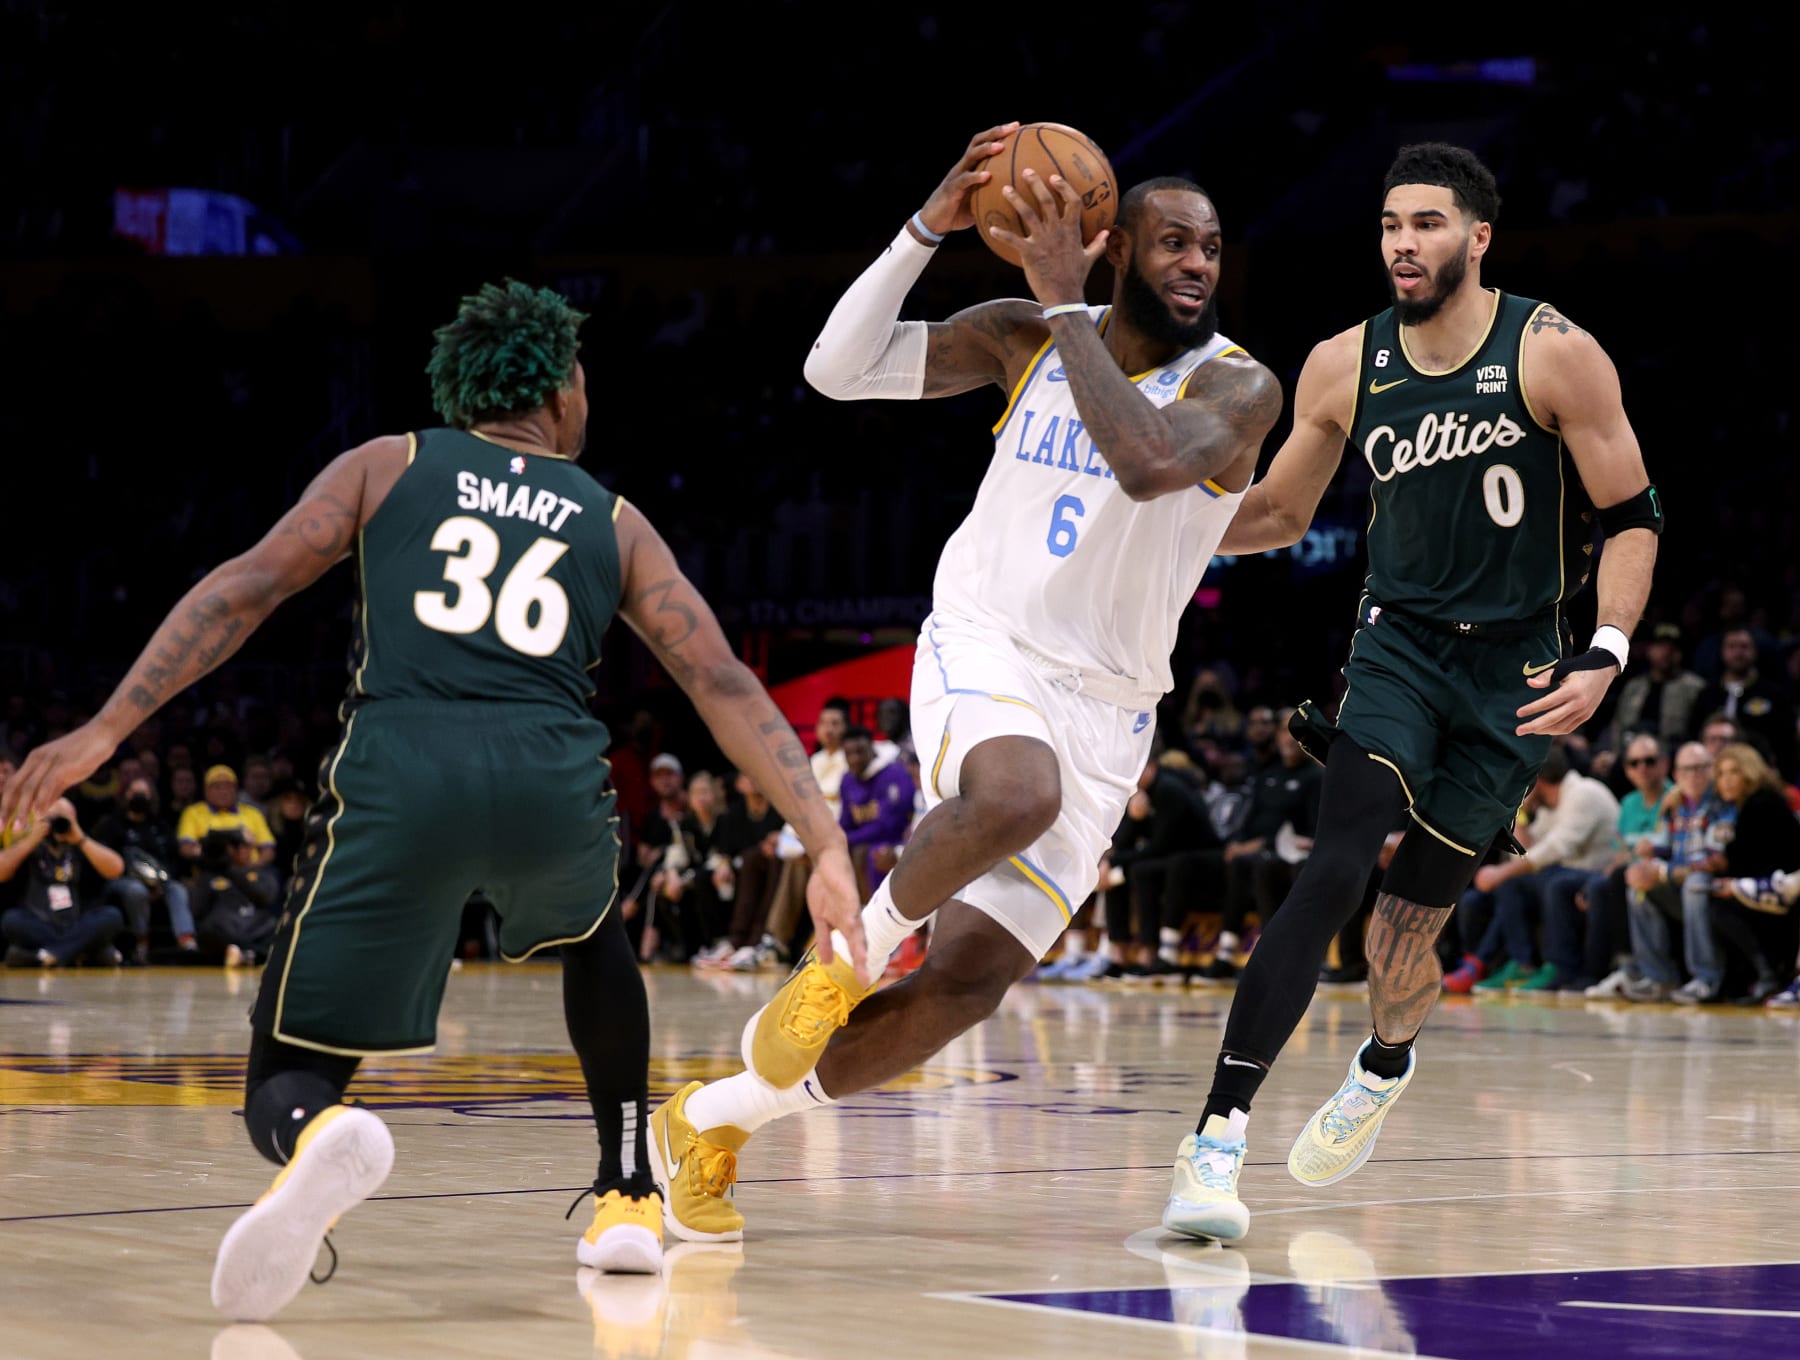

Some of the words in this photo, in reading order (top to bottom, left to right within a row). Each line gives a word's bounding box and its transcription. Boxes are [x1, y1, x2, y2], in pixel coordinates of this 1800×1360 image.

[1375, 349, 1390, 368] 6
[1475, 380, 1508, 395] PRINT
[1476, 364, 1507, 382] VISTA
[1015, 410, 1119, 481] LAKE
[1364, 411, 1527, 482] Celtics
[457, 470, 583, 533] SMART
[1046, 494, 1086, 558] 6
[1482, 464, 1525, 528] 0
[413, 515, 570, 658] 36
